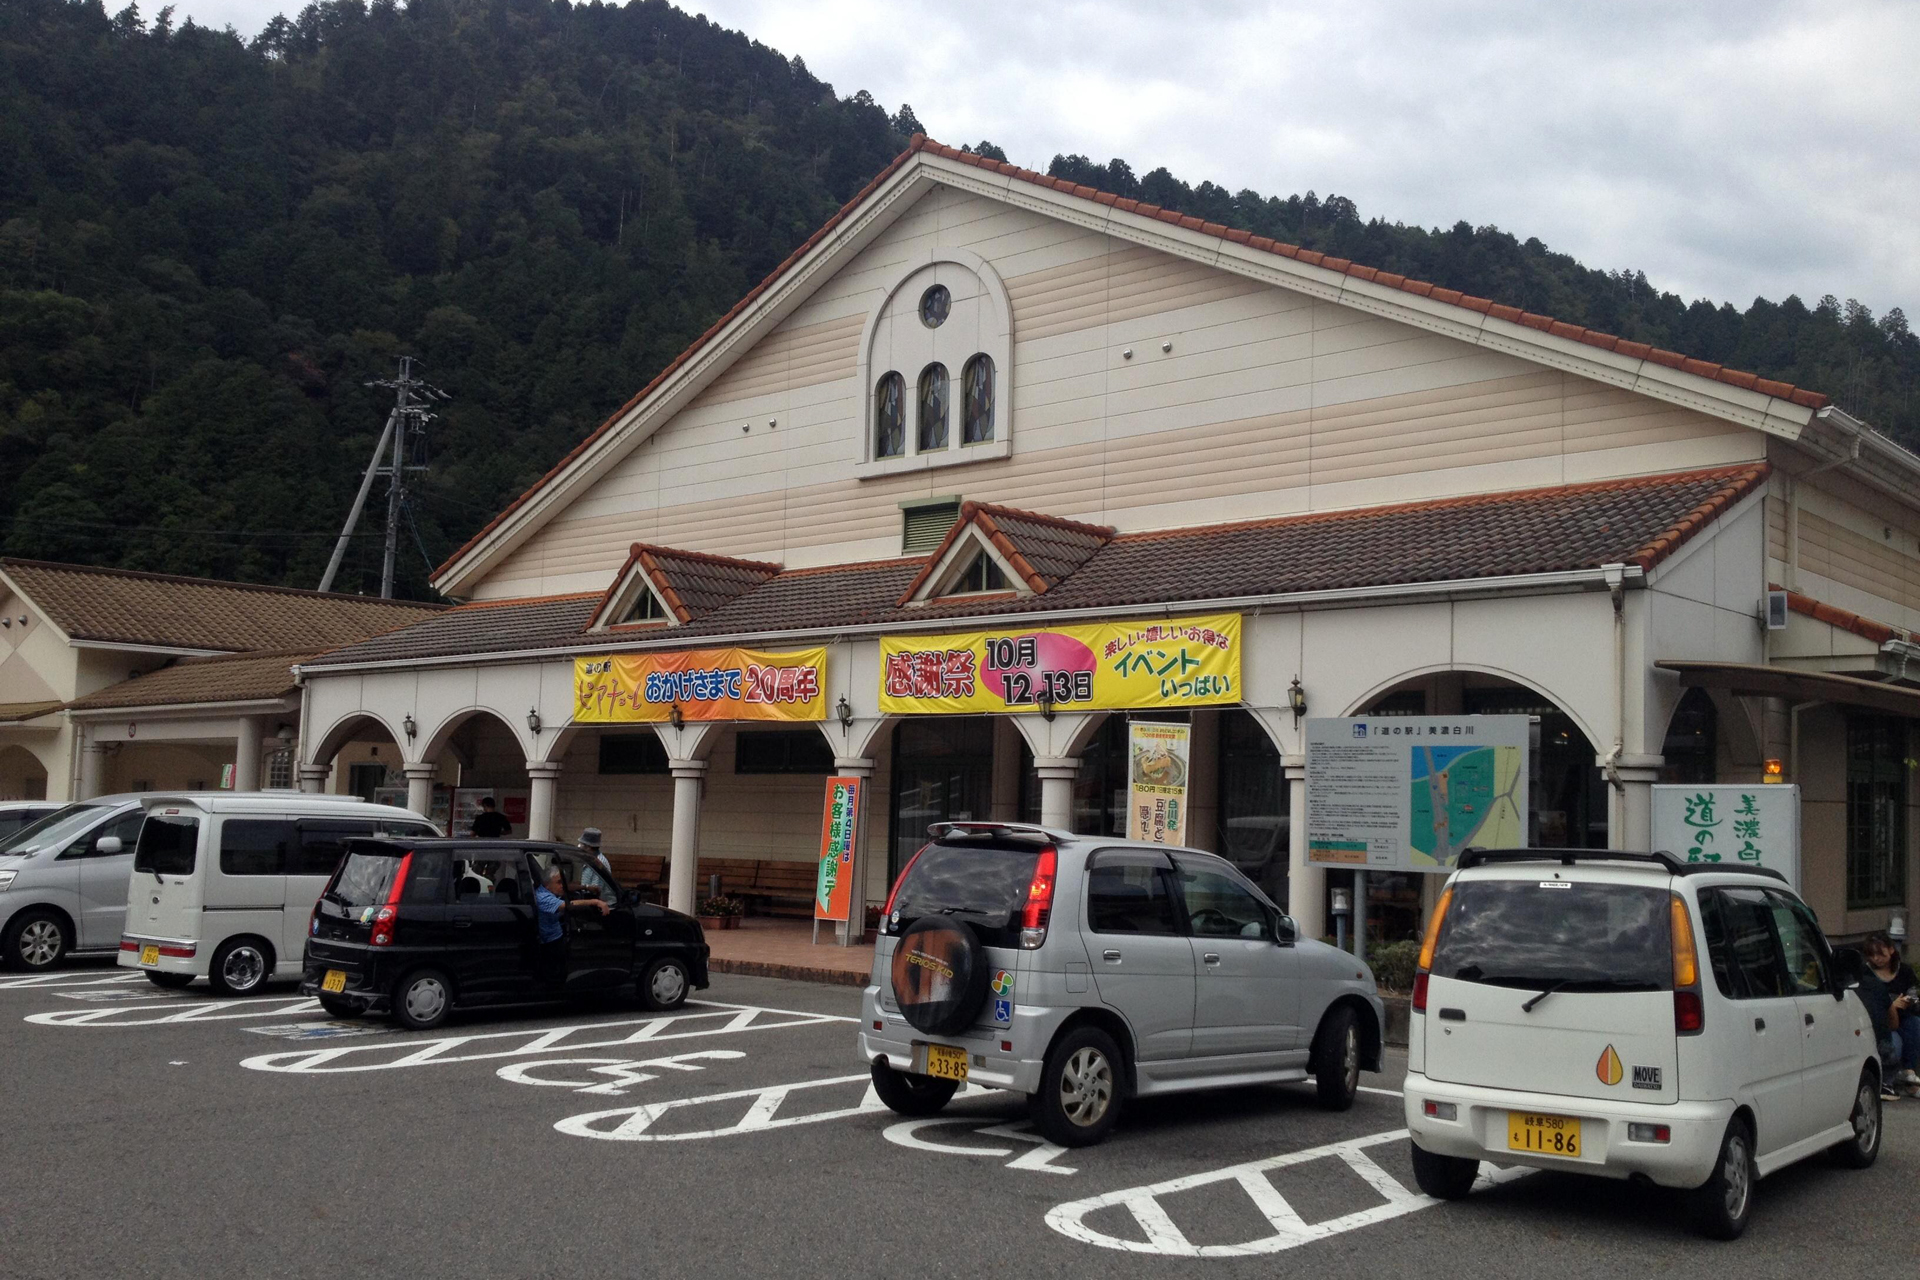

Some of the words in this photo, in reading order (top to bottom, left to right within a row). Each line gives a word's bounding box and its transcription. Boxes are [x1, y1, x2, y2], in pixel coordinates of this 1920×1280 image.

[586, 661, 612, 674] 道の駅
[985, 637, 1037, 671] 10月
[1113, 648, 1200, 678] イベント
[645, 668, 742, 703] おかげさまで
[744, 664, 819, 704] 20周年
[885, 650, 976, 698] 感謝祭
[1161, 675, 1230, 697] いっぱい
[1139, 805, 1150, 840] 隠れ
[1153, 798, 1165, 843] 豆腐と
[1167, 798, 1179, 831] 白川発
[1733, 794, 1763, 867] 美濃白
[825, 784, 844, 914] お客様感謝デー
[905, 953, 936, 970] TERIOS
[937, 966, 954, 978] KID
[937, 1058, 966, 1078] 33-85
[1634, 1066, 1660, 1083] MOVE
[1527, 1129, 1576, 1152] 11-86
